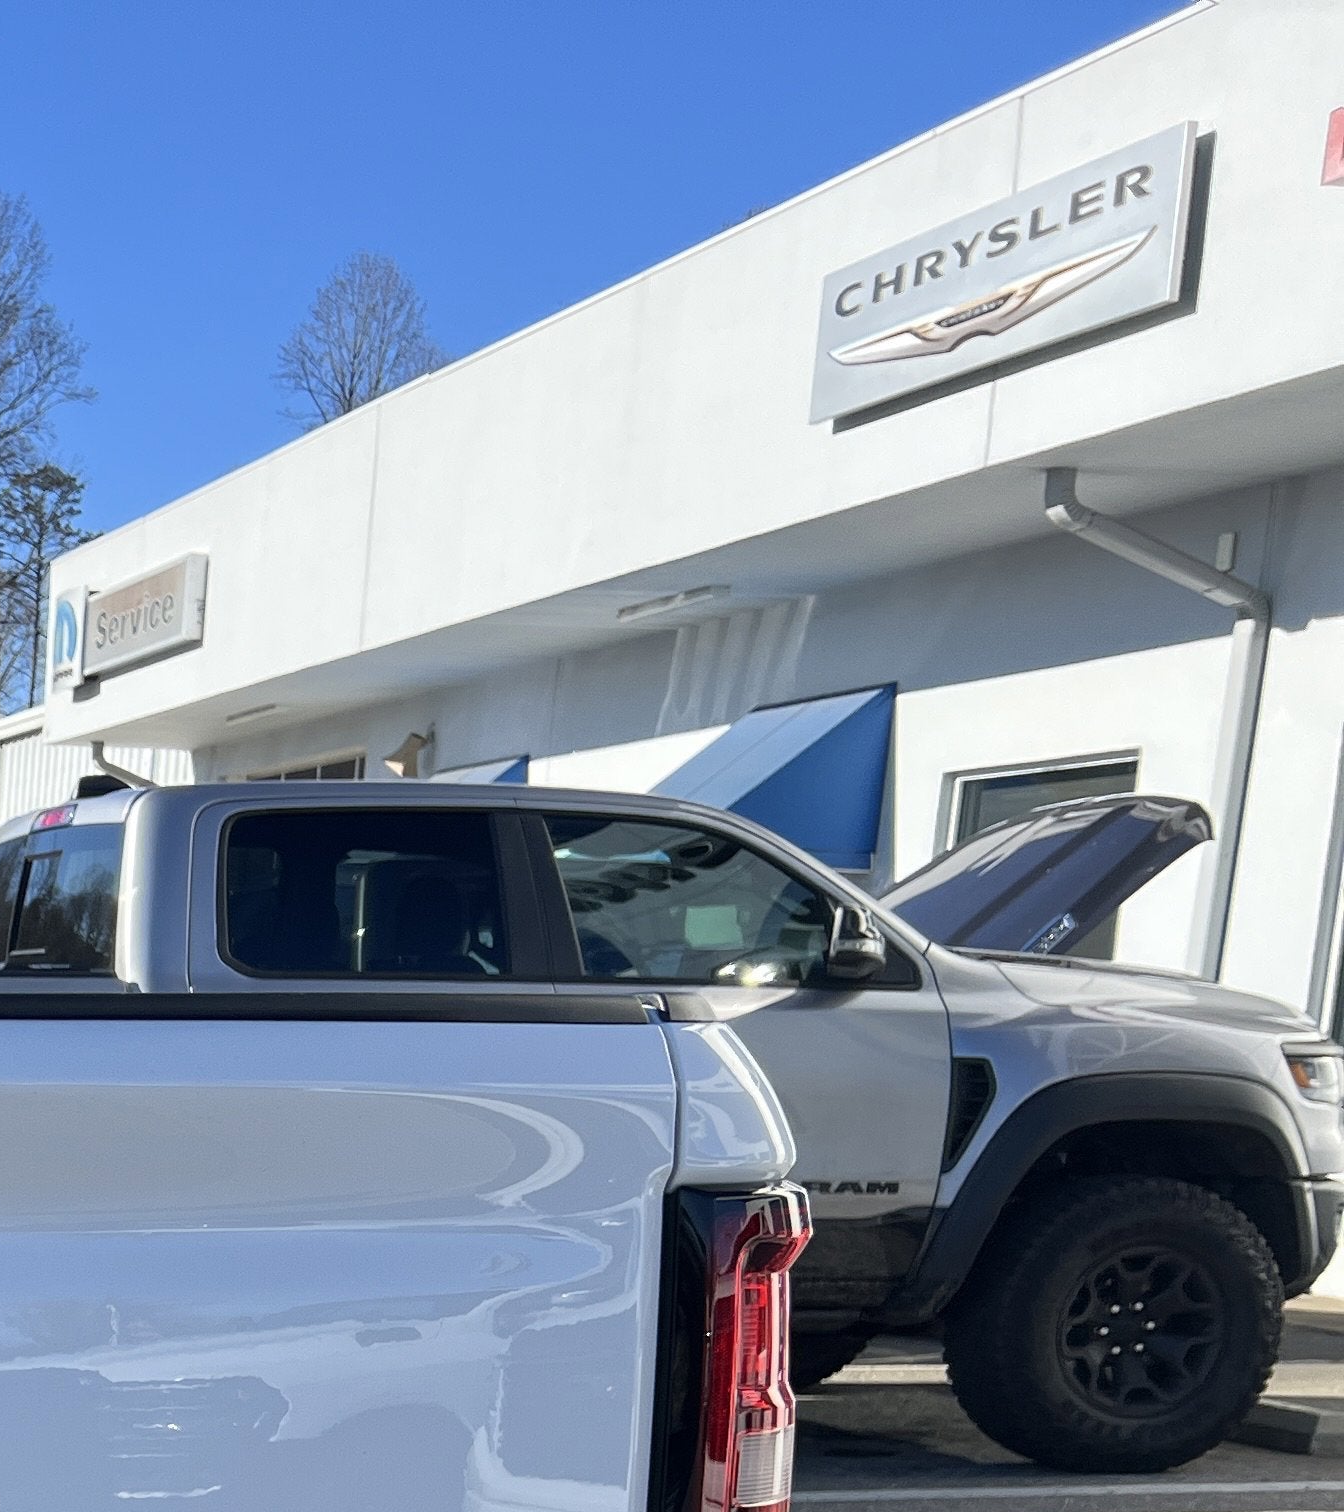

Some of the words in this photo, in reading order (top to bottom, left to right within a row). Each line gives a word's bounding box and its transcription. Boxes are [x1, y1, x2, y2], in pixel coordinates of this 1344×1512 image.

[834, 163, 1154, 318] CHRYSLER
[95, 590, 174, 649] Service
[800, 1181, 900, 1195] RAM
